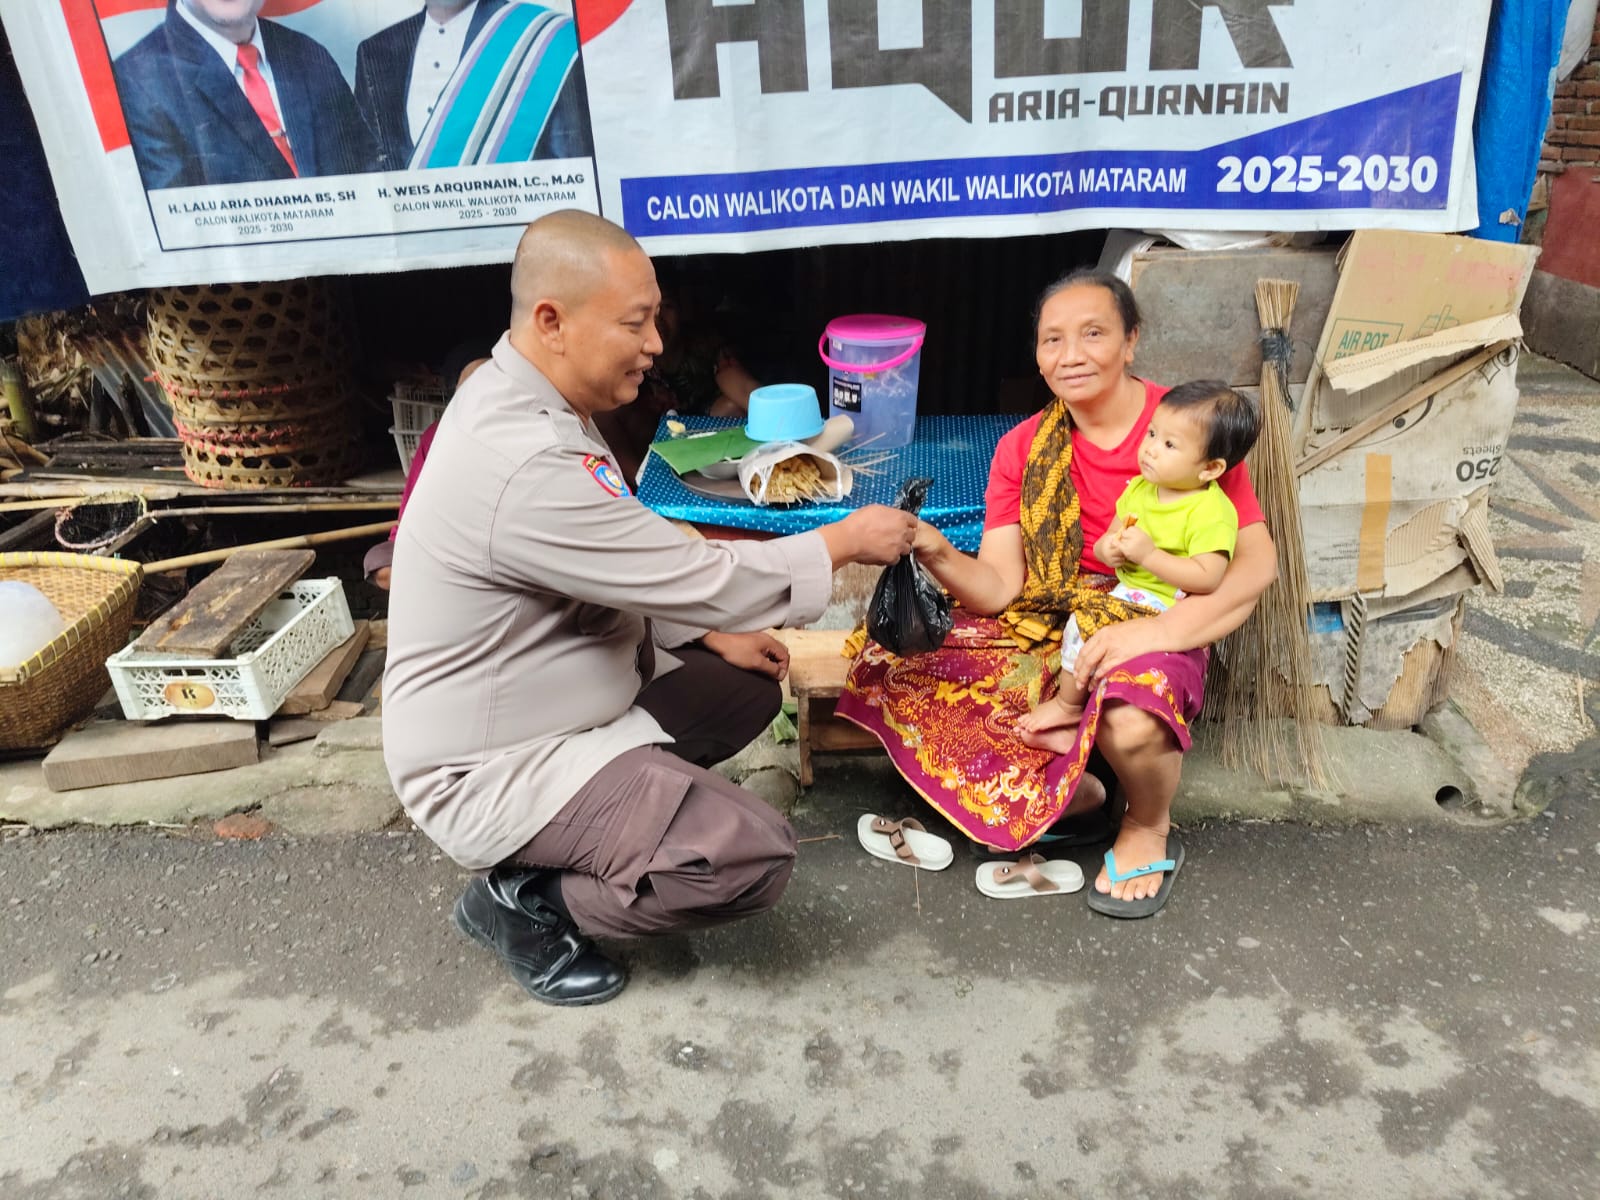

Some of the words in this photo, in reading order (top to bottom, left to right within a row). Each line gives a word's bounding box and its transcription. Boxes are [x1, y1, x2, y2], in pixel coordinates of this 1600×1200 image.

[988, 82, 1290, 124] ARIA-QURNAIN
[1215, 154, 1438, 193] 2025-2030
[378, 187, 392, 198] H.
[394, 184, 431, 197] WEIS
[434, 178, 522, 194] ARQURNAIN,
[551, 174, 585, 185] M.AG
[647, 193, 719, 222] CALON
[725, 186, 835, 217] WALIKOTA
[840, 182, 886, 209] DAN
[891, 176, 960, 205] WAKIL
[966, 171, 1075, 200] WALIKOTA
[1078, 167, 1188, 194] MATARAM
[168, 203, 182, 214] H.
[184, 201, 217, 214] LALU
[220, 197, 251, 210] ARIA
[254, 193, 312, 208] DHARMA
[315, 192, 336, 204] BS,
[338, 190, 356, 202] SH
[393, 201, 430, 213] CALON
[433, 198, 465, 210] WAKIL
[467, 194, 521, 207] WALIKOTA
[524, 191, 577, 203] MATARAM
[459, 209, 483, 220] 2025
[493, 207, 517, 217] 2030
[194, 215, 228, 227] CALON
[230, 211, 281, 225] WALIKOTA
[283, 208, 334, 221] MATARAM
[238, 225, 262, 235] 2025
[271, 223, 294, 233] 2030
[1338, 329, 1362, 351] AIR
[1361, 331, 1389, 352] POT
[1456, 456, 1502, 482] 250
